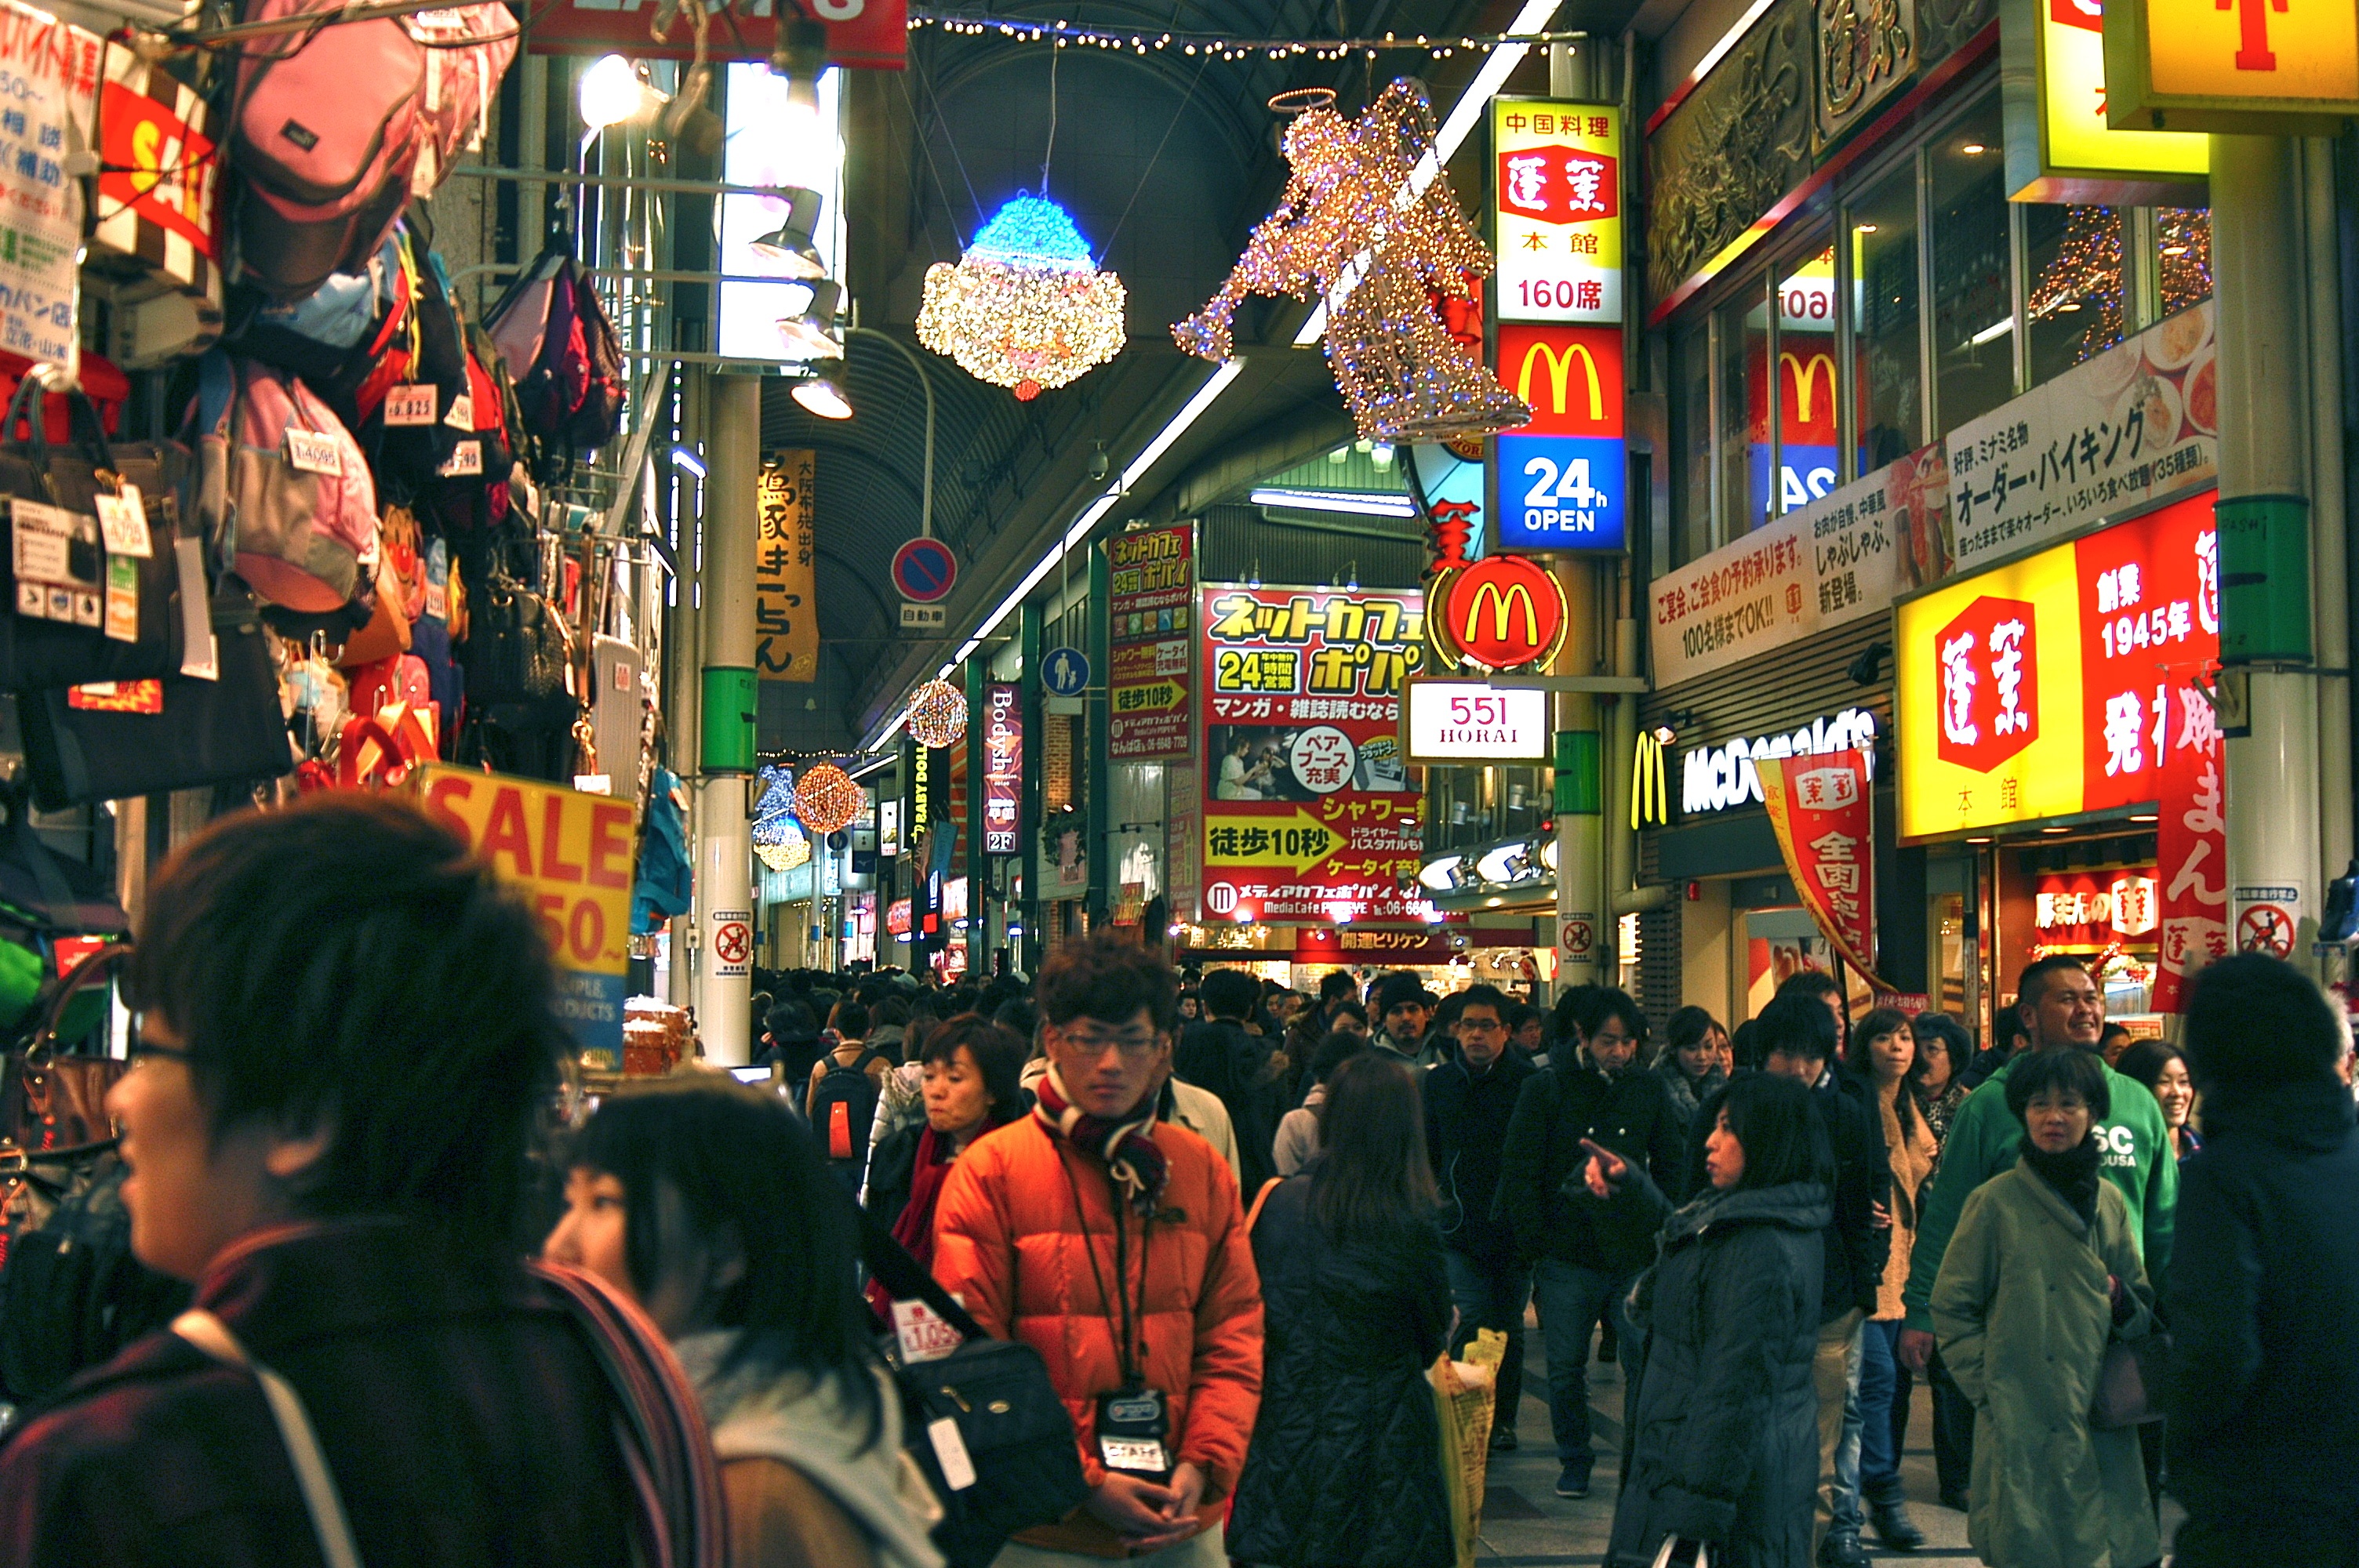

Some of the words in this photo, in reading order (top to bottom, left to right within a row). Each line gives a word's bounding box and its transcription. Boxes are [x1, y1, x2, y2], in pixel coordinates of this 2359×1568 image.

[1506, 113, 1609, 137] 中国料理
[1521, 232, 1598, 255] 本館
[1519, 279, 1602, 310] 160席
[1957, 402, 2146, 527] オーダー・バイキング
[1525, 510, 1595, 532] OPEN
[1114, 532, 1181, 566] ネットカフェ
[1143, 557, 1189, 592] ポパイ
[2097, 562, 2143, 615] 創業
[903, 608, 943, 622] 自動車
[1212, 596, 1424, 642] ネットカフェ
[2101, 601, 2192, 659] 1945年
[1157, 644, 1187, 659] ケータイ
[1118, 686, 1173, 710] 徒歩10秒
[1213, 698, 1398, 720] マンガ・雑誌読むなら
[1451, 697, 1506, 725] 551
[1306, 734, 1340, 751] ペア
[1440, 728, 1518, 744] HORAI
[1297, 751, 1349, 768] ブース
[1306, 767, 1340, 785] 充実
[915, 782, 928, 823] BABY
[1958, 777, 2019, 817] 本館
[428, 776, 633, 890] SALE
[989, 834, 1012, 850] 2F
[1210, 827, 1329, 857] 徒歩10秒
[1263, 902, 1294, 914] Media
[1295, 902, 1319, 914] Cafe
[1340, 931, 1430, 949] 開運ビリケン
